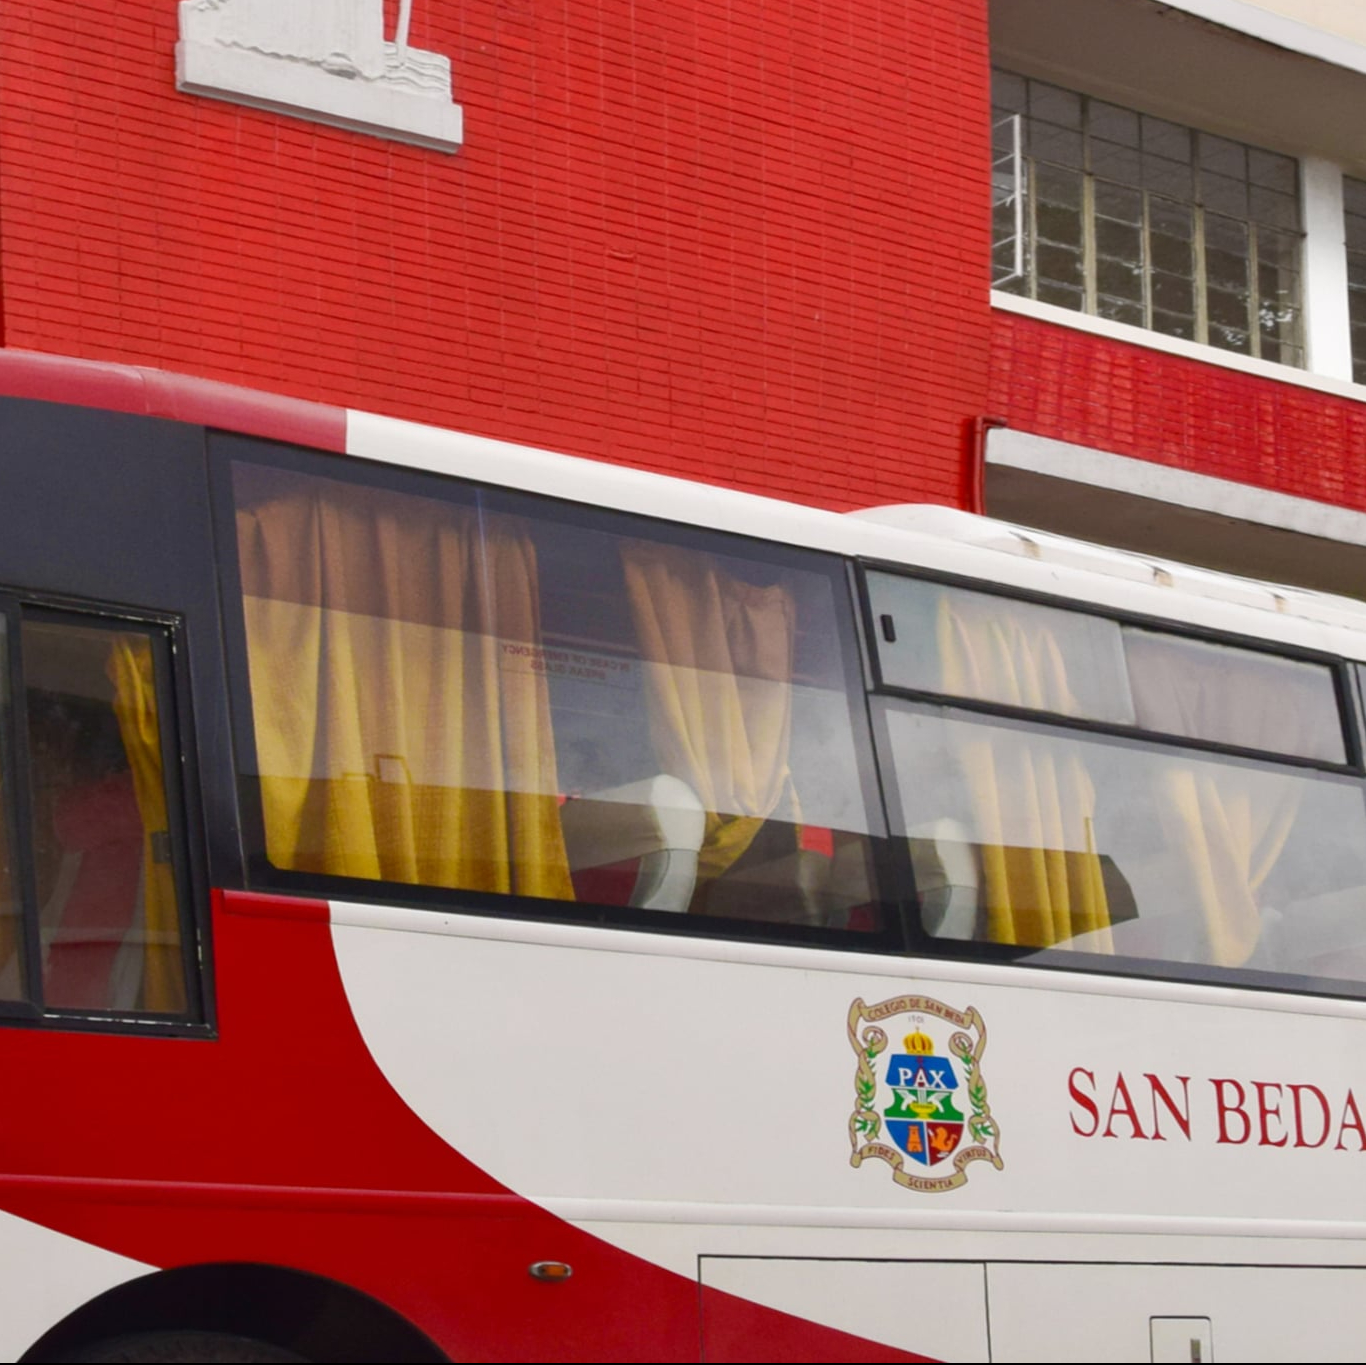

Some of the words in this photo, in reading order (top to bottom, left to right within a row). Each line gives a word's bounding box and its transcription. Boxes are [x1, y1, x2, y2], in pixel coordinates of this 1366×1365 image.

[868, 999, 907, 1018] COLEGIO
[909, 998, 920, 1008] DE
[924, 1000, 944, 1014] SAN
[944, 1009, 965, 1024] BEDA
[898, 1068, 948, 1089] PAX
[1068, 1067, 1191, 1142] SAN
[868, 1146, 895, 1161] FIDES
[957, 1148, 987, 1164] VIRTUS
[907, 1177, 954, 1190] SCIENTIA
